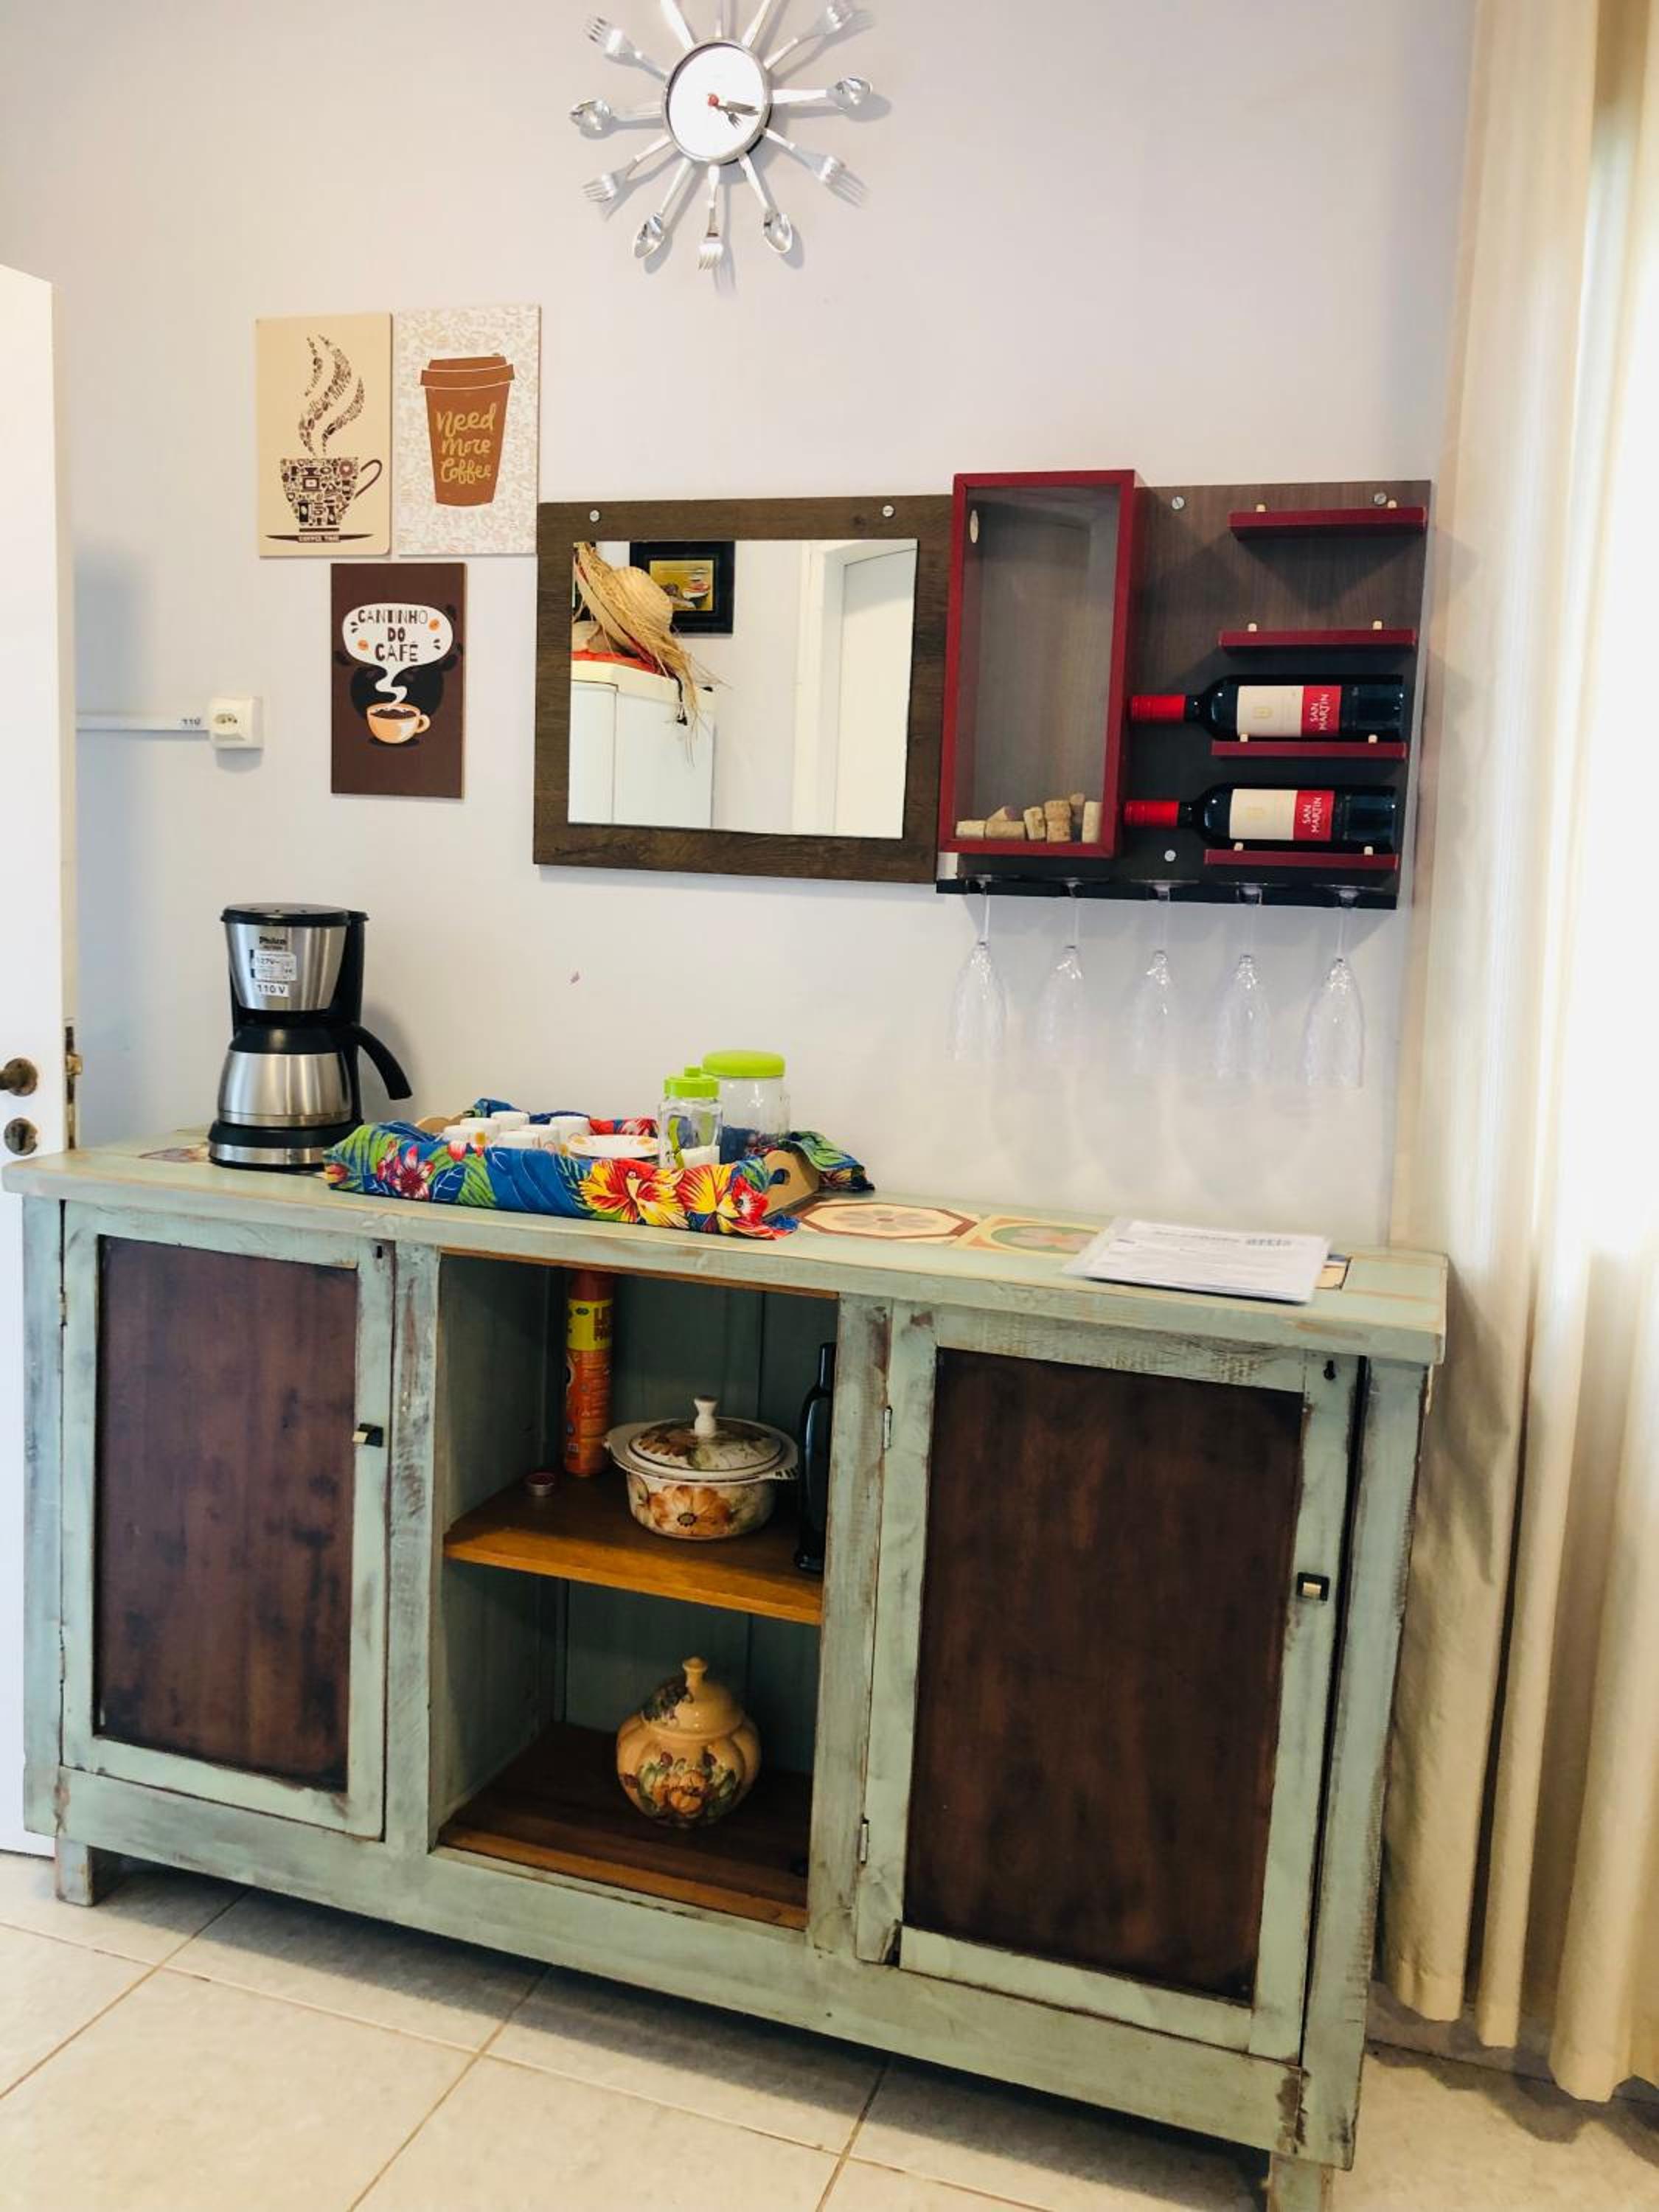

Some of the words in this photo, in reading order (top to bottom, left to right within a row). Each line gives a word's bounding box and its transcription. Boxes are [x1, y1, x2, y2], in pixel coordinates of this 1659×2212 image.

[436, 402, 497, 437] Need
[440, 457, 493, 484] Coffee
[358, 609, 428, 625] CANTINHO
[387, 626, 406, 642] DO
[375, 641, 419, 662] CAFÉ
[1310, 702, 1319, 723] SAN
[1319, 693, 1330, 731] MARTIN
[1302, 804, 1312, 824] SAN
[1311, 797, 1322, 833] MARTIN
